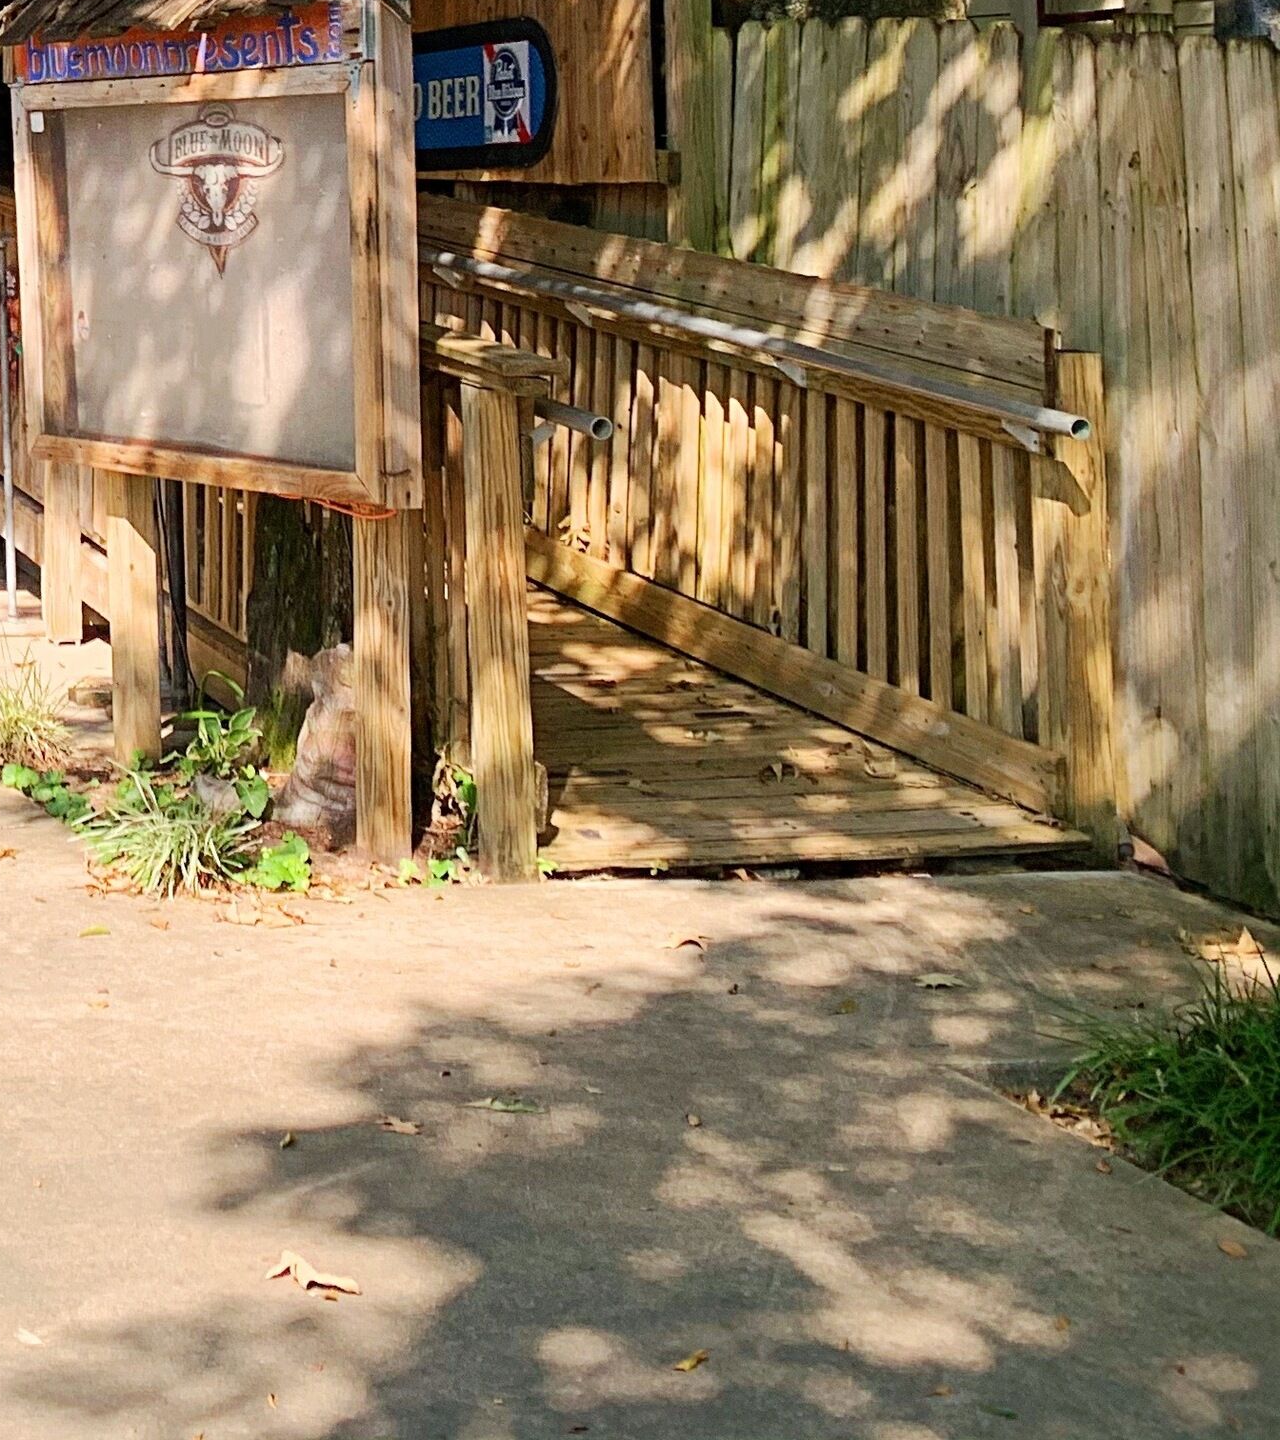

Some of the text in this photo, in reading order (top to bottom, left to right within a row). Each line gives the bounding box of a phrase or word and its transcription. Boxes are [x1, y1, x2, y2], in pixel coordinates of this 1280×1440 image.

[427, 75, 481, 120] BEER
[174, 128, 264, 160] BLUE MOON
